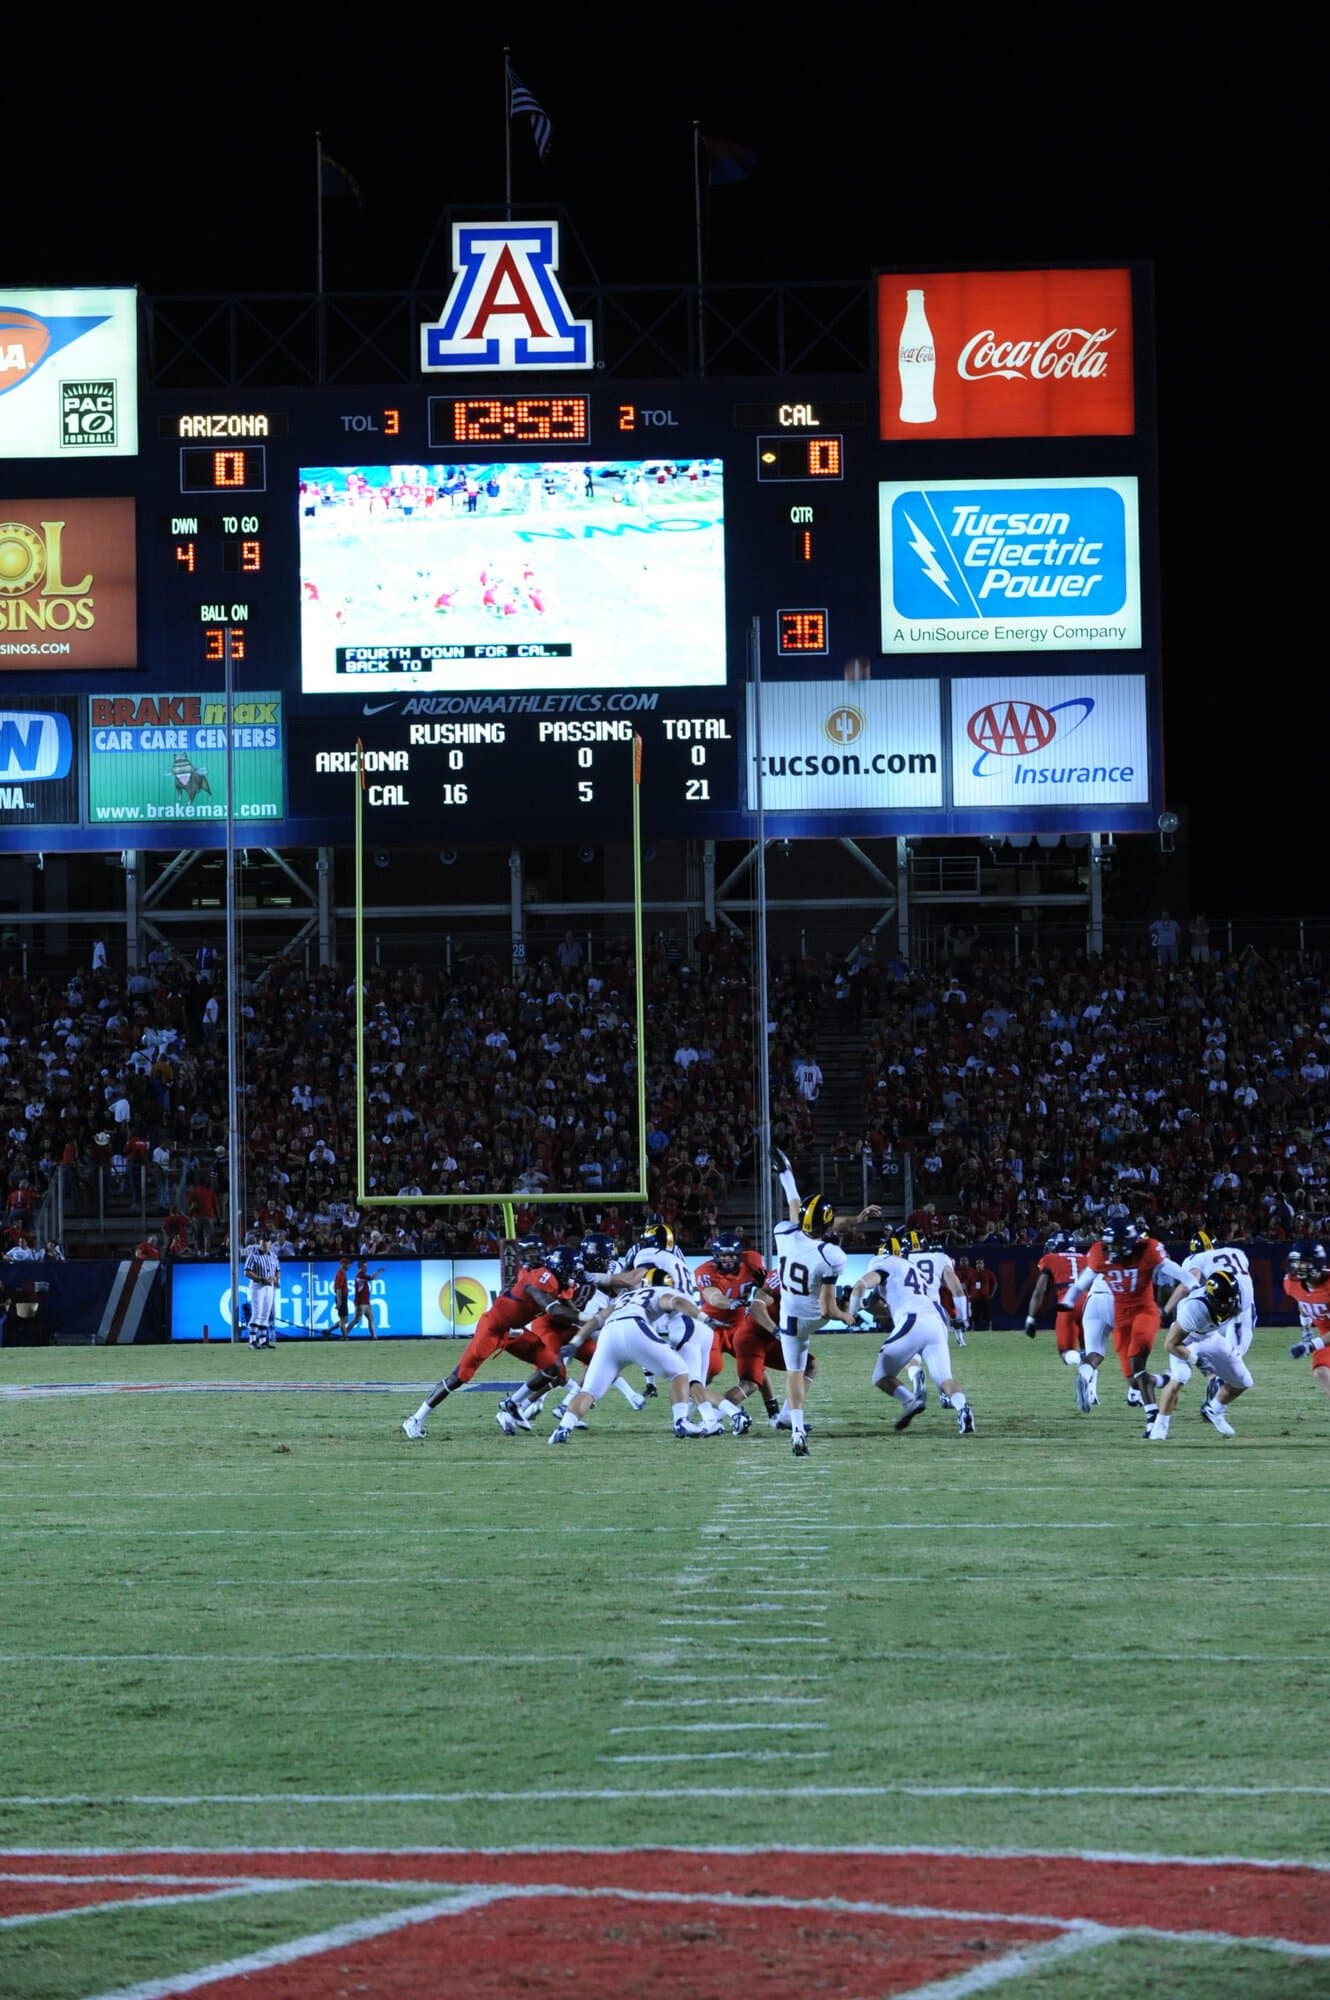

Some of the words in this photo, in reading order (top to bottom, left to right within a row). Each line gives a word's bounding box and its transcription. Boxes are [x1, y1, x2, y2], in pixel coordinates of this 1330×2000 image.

[421, 221, 593, 373] A
[957, 327, 1117, 380] Coca-Cola
[64, 397, 113, 412] PAC
[779, 404, 820, 426] CAL
[64, 413, 113, 434] 10
[179, 415, 269, 437] ARIZONA
[341, 414, 378, 432] TOL
[384, 410, 399, 434] 3
[454, 399, 585, 441] 12:59
[619, 406, 634, 430] 2
[641, 409, 678, 427] TOL
[64, 434, 113, 443] FOOTBALL
[214, 452, 244, 485] 0
[808, 440, 839, 474] 0
[172, 518, 198, 534] DWN
[222, 517, 238, 533] TO
[241, 516, 259, 533] GO
[790, 506, 813, 523] QTR
[951, 505, 1070, 536] Tucson
[176, 542, 195, 572] 4
[242, 541, 260, 571] 9
[803, 531, 812, 560] 1
[963, 536, 1104, 568] Electric
[978, 569, 1103, 599] Power
[201, 605, 228, 621] BALL
[231, 604, 248, 621] ON
[206, 629, 244, 659] 35
[894, 629, 905, 642] A
[910, 626, 989, 642] UniSource
[994, 626, 1048, 643] Energy
[1052, 624, 1127, 642] Company
[346, 647, 411, 660] FOURTH
[421, 646, 465, 659] DOWN
[475, 646, 508, 658] FOR
[518, 645, 558, 658] CAL.
[346, 660, 389, 673] BACK
[399, 659, 422, 672] TO
[91, 697, 201, 727] BRAKE
[203, 702, 280, 725] max
[401, 693, 659, 716] ARIZONAATHLETICS.COM
[95, 731, 134, 750] CAR
[140, 730, 188, 750] CARE
[195, 727, 276, 749] CENTERS
[410, 723, 506, 745] RUSHING
[539, 721, 633, 742] PASSING
[663, 719, 731, 740] TOTAL
[978, 703, 1047, 752] AAA
[316, 750, 409, 773] ARIZONA
[449, 749, 464, 770] 0
[578, 747, 593, 768] 0
[691, 745, 705, 766] 0
[1013, 764, 1134, 785] Insurance
[369, 784, 409, 806] CAL
[443, 783, 468, 805] 16
[579, 781, 593, 803] 5
[685, 778, 710, 801] 21
[512, 943, 525, 957] 28
[882, 1163, 899, 1175] 29
[502, 1245, 517, 1293] ARIZ
[779, 1256, 810, 1296] 19
[1212, 1252, 1249, 1277] 31
[539, 1272, 552, 1285] 9
[1107, 1268, 1141, 1294] 27
